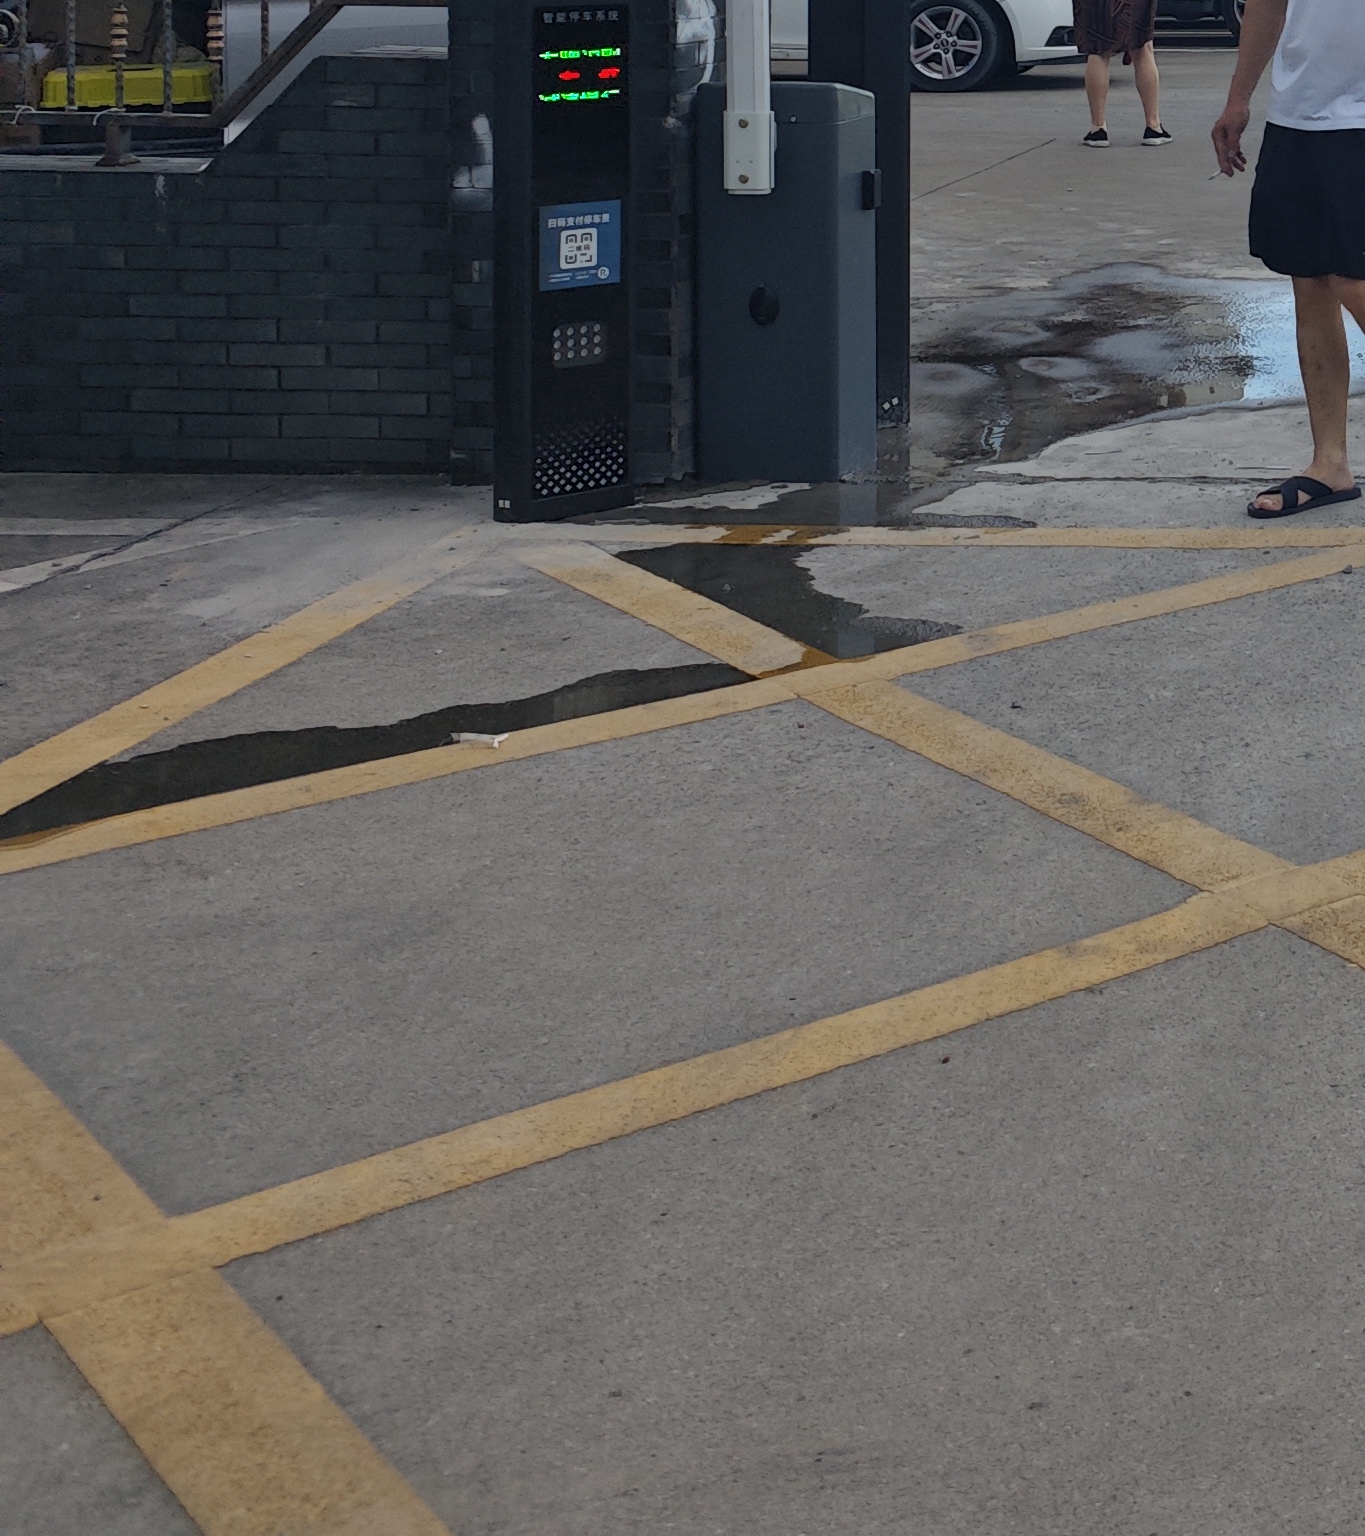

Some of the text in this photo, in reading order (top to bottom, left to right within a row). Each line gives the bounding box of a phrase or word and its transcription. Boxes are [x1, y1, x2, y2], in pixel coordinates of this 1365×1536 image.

[543, 10, 619, 24] 智能停车系统
